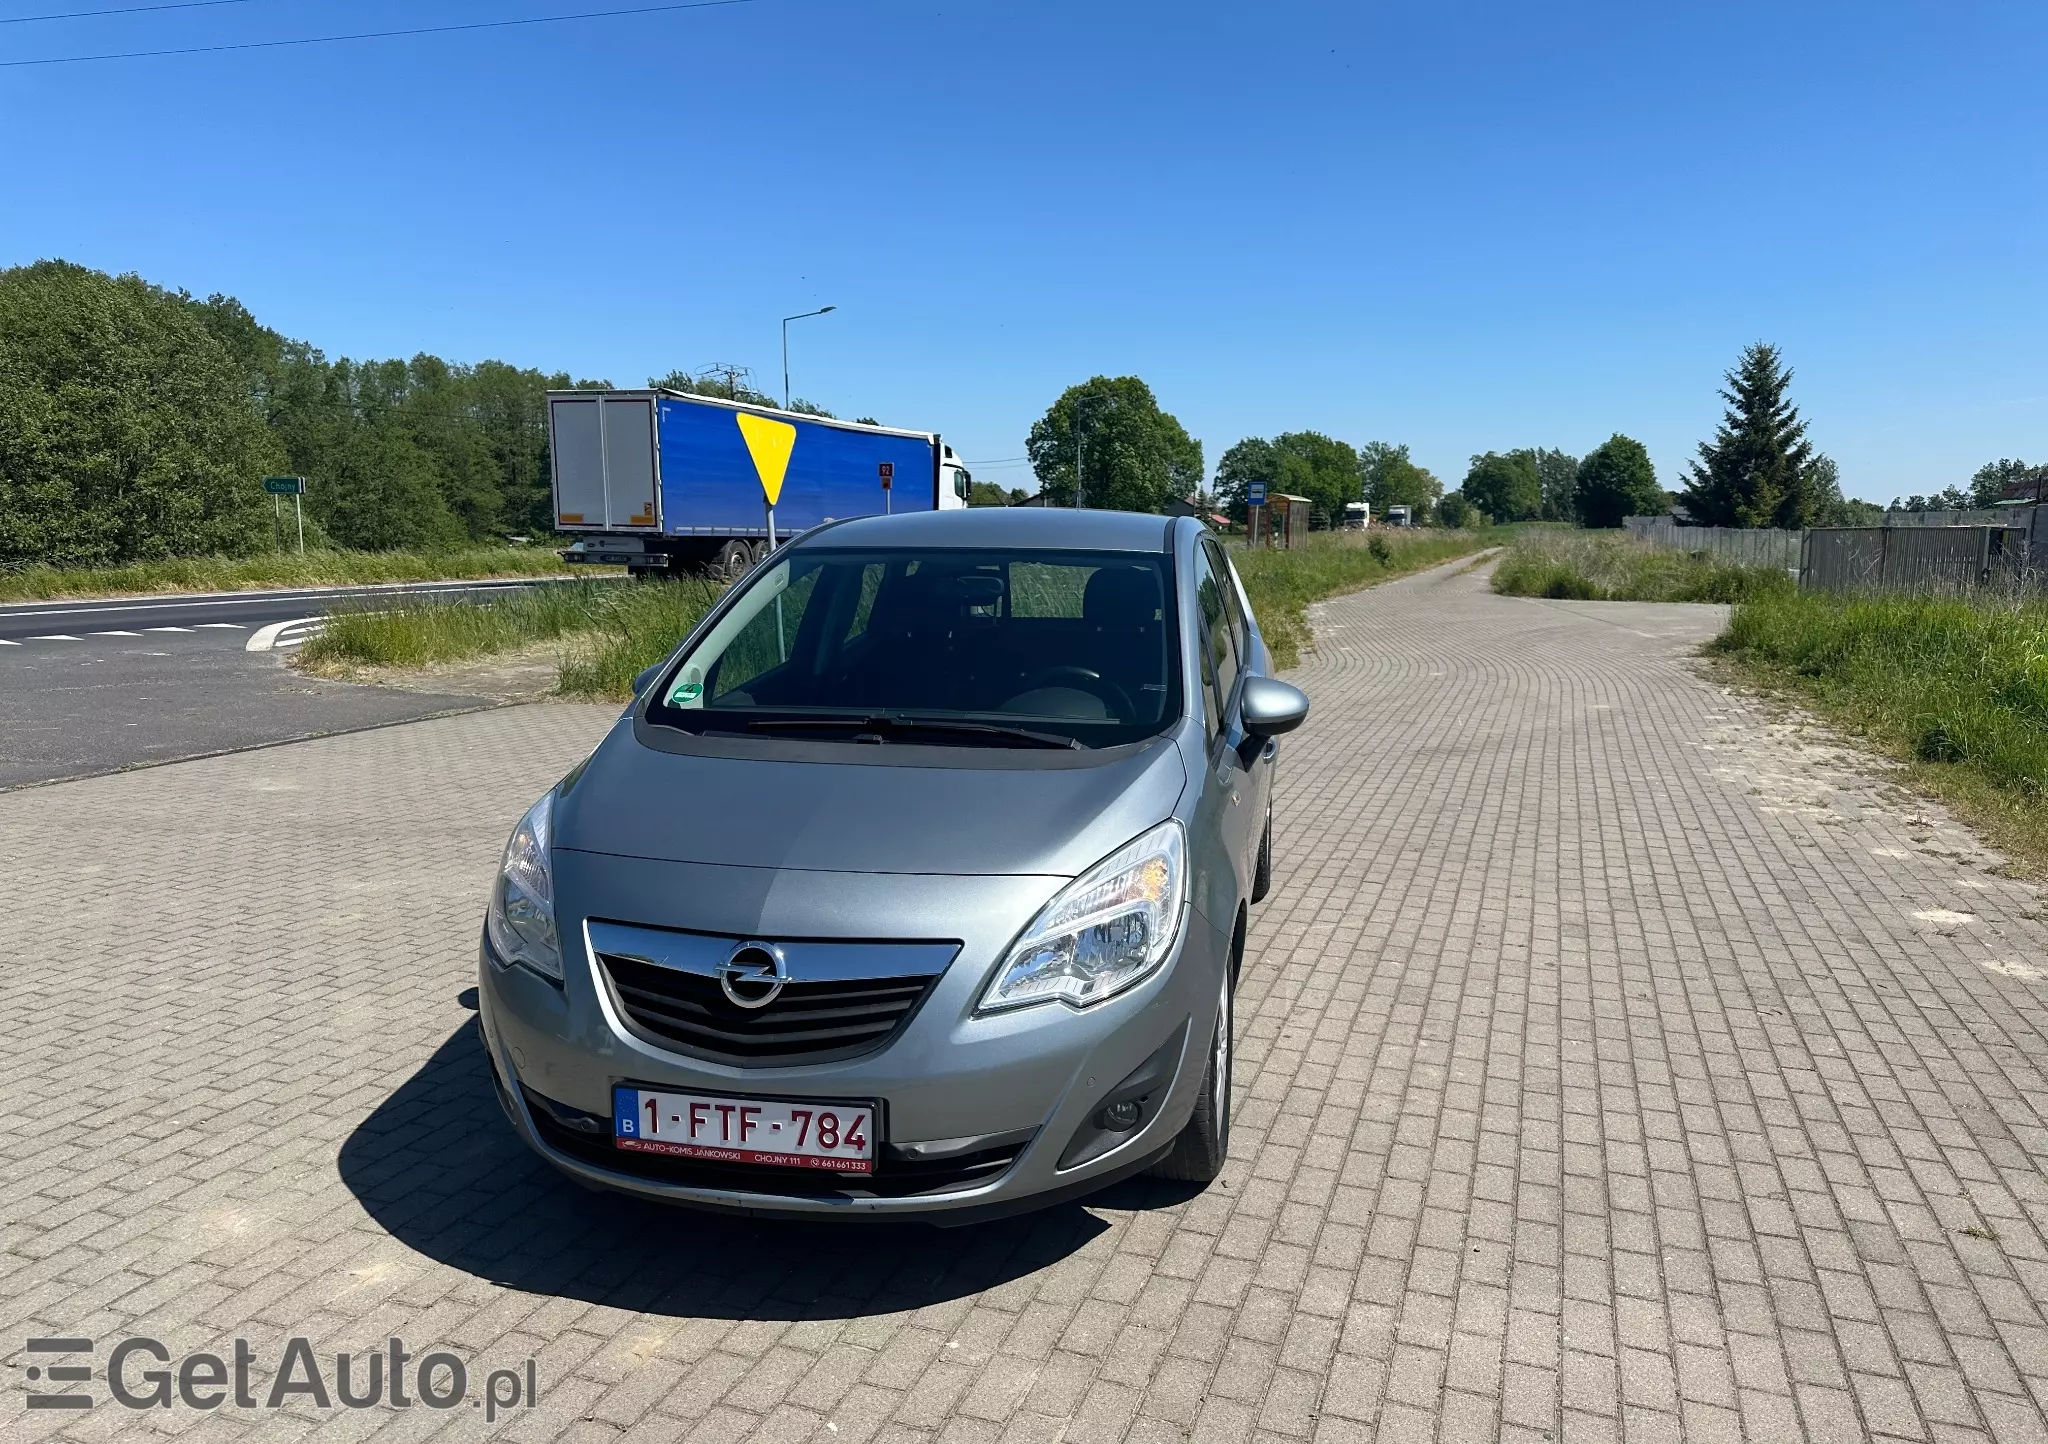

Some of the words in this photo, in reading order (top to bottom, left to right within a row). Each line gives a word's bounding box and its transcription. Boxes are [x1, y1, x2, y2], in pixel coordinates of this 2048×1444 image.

[881, 465, 890, 475] 92
[270, 481, 296, 491] Chojny
[622, 1119, 635, 1133] B
[644, 1098, 867, 1151] 1-FTF-784
[643, 1142, 693, 1155] AUTO-KOMIS
[694, 1149, 741, 1160] JANKOWSKI
[754, 1154, 788, 1165] CHOJNY
[789, 1157, 801, 1165] 111
[821, 1160, 835, 1168] 661
[836, 1161, 850, 1169] 661
[851, 1162, 866, 1170] 333
